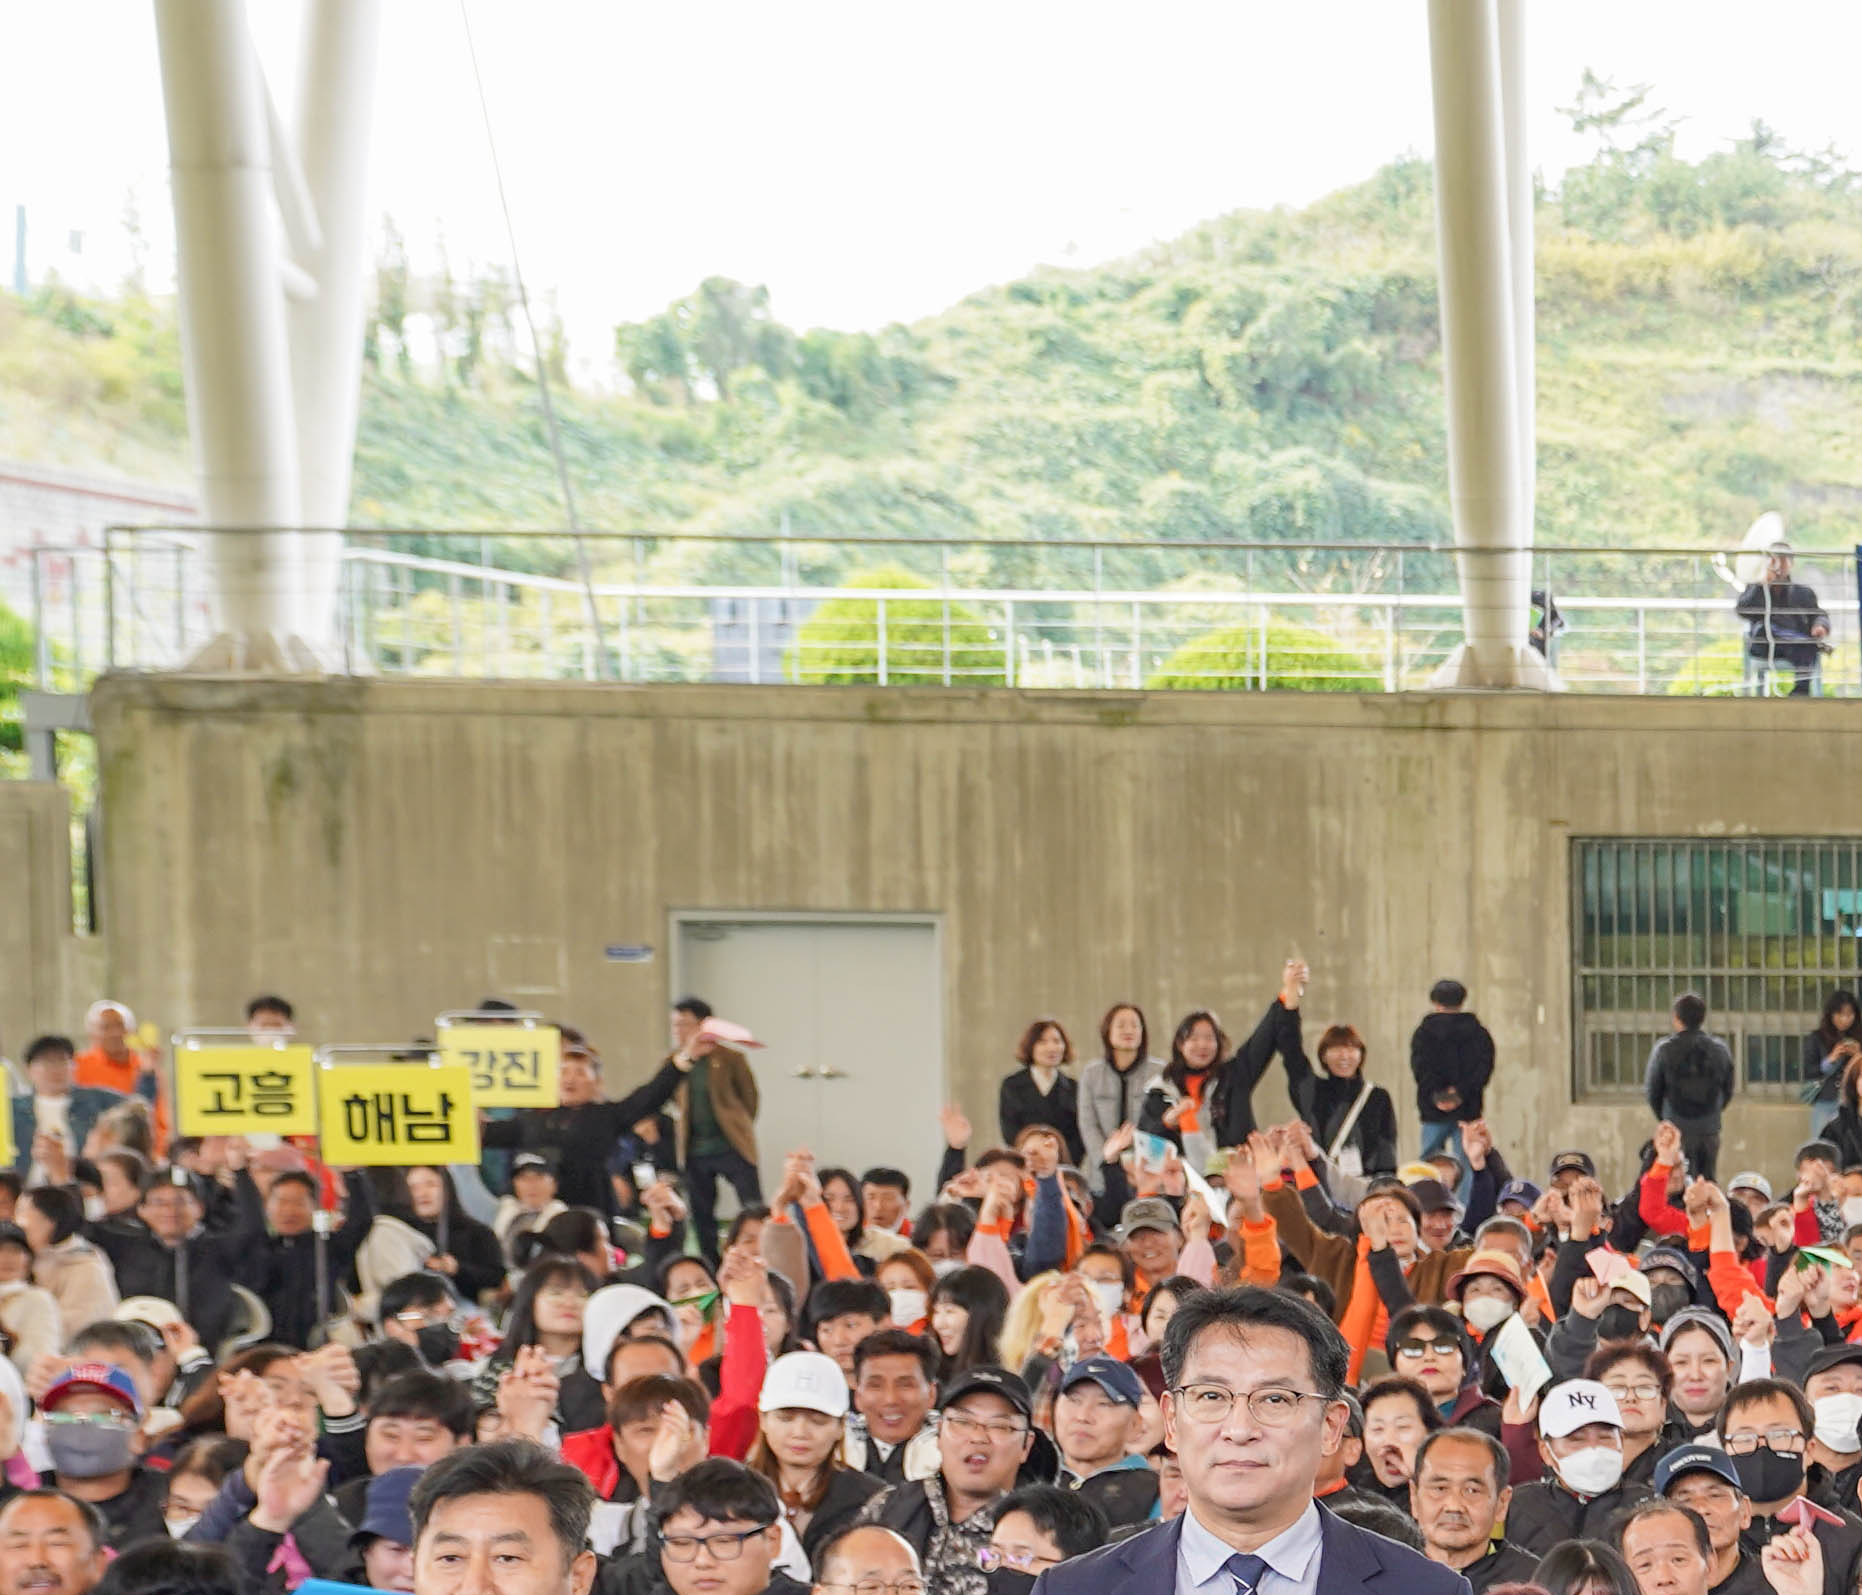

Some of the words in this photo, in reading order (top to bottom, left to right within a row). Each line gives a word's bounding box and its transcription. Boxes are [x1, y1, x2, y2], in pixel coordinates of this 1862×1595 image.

[459, 1049, 541, 1091] 강진
[200, 1070, 295, 1118] 고흥
[341, 1092, 455, 1145] 해남
[1568, 1391, 1598, 1410] NY
